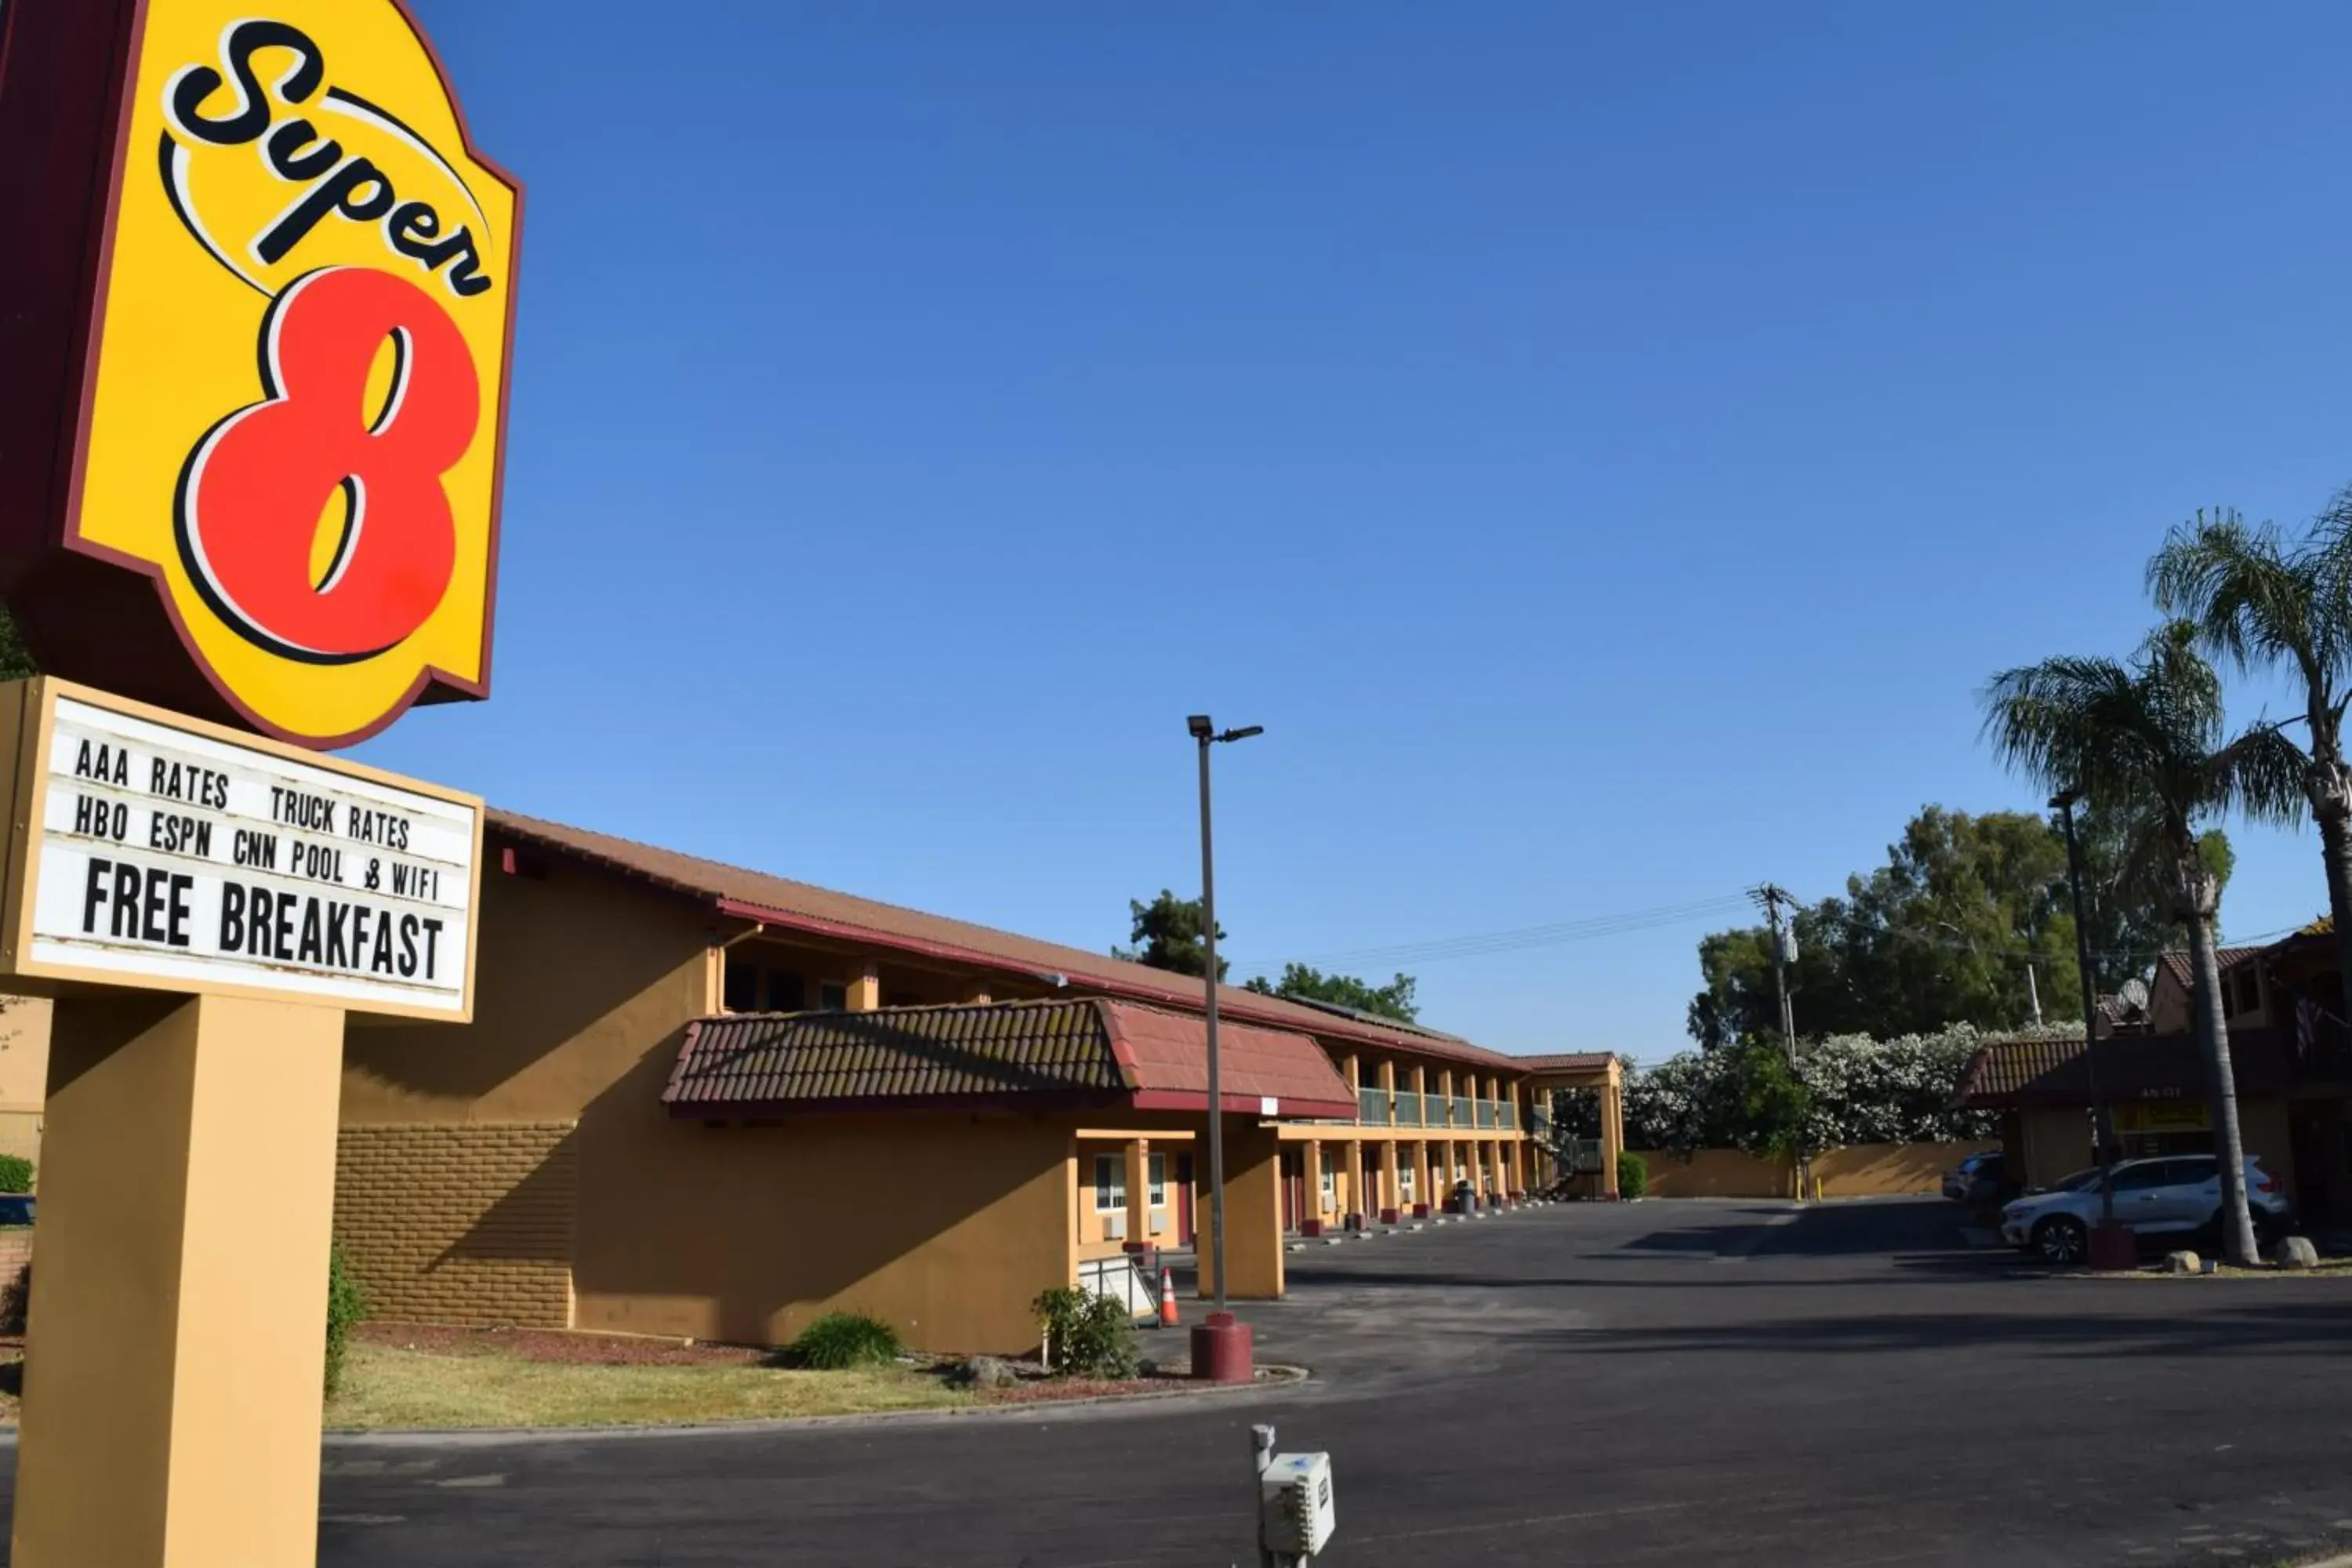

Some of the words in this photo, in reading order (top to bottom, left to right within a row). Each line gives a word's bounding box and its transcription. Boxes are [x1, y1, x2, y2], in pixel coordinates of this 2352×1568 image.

[166, 20, 492, 297] Super
[172, 266, 480, 665] 8
[74, 794, 128, 841] HBO
[150, 811, 212, 857] ESPN
[233, 829, 276, 869] CNN
[292, 840, 343, 883] POOL
[364, 858, 380, 890] &
[393, 862, 438, 901] WIFI
[75, 739, 128, 786] AAA
[151, 757, 228, 810] RATES
[271, 786, 335, 833] TRUCK
[349, 806, 409, 851] RATES
[83, 858, 194, 947] FREE
[220, 881, 443, 979] BREAKFAST
